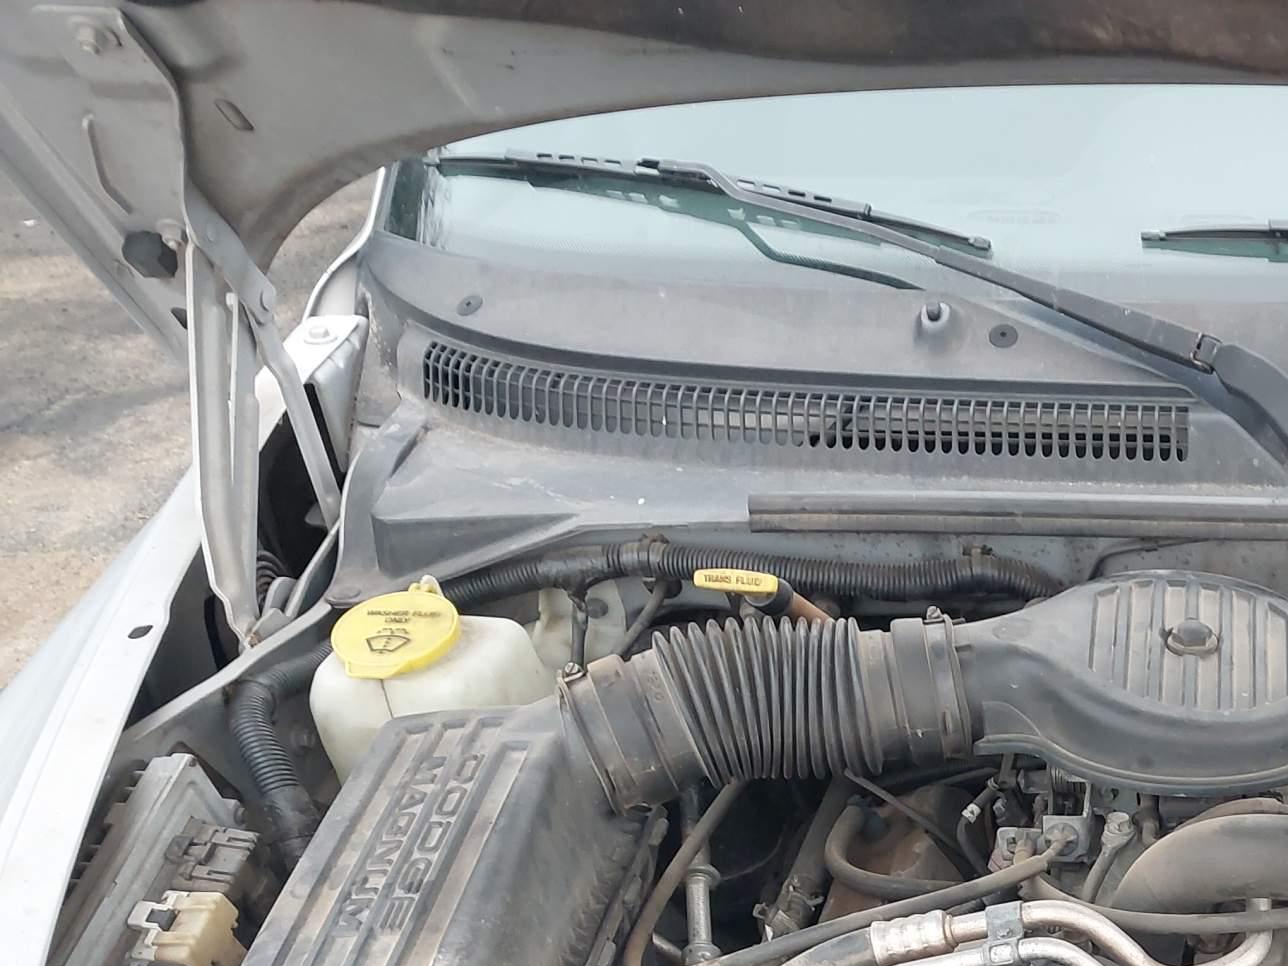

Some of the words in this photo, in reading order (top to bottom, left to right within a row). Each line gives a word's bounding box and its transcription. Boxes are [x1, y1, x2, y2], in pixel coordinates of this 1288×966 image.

[704, 574, 731, 584] TRANS
[338, 756, 446, 935] MAGNUM
[376, 753, 485, 932] DODGE
